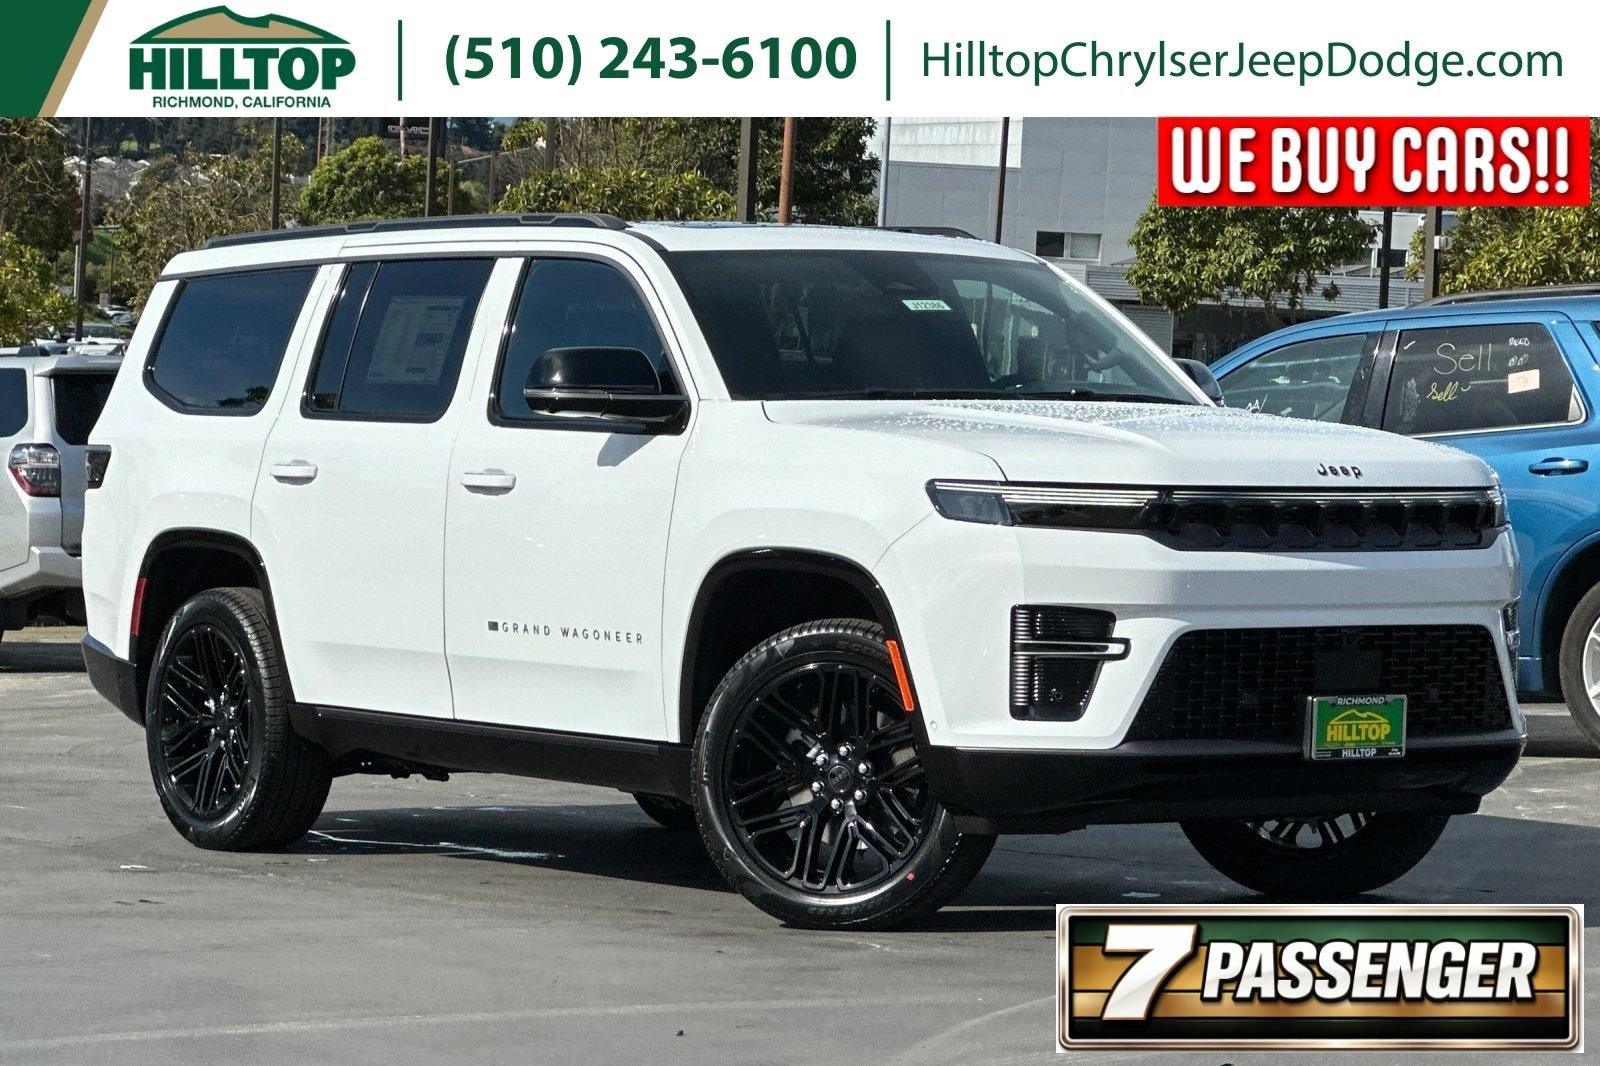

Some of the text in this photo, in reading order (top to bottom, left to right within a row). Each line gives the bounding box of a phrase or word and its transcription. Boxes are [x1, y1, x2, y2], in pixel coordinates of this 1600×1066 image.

[1433, 343, 1492, 374] Sell
[1317, 463, 1362, 479] Jeep
[502, 622, 643, 644] GRAND WAGONEER
[1337, 697, 1384, 705] RICHMOND
[1327, 724, 1391, 741] HILLTOP
[1342, 749, 1377, 757] HILLTOP
